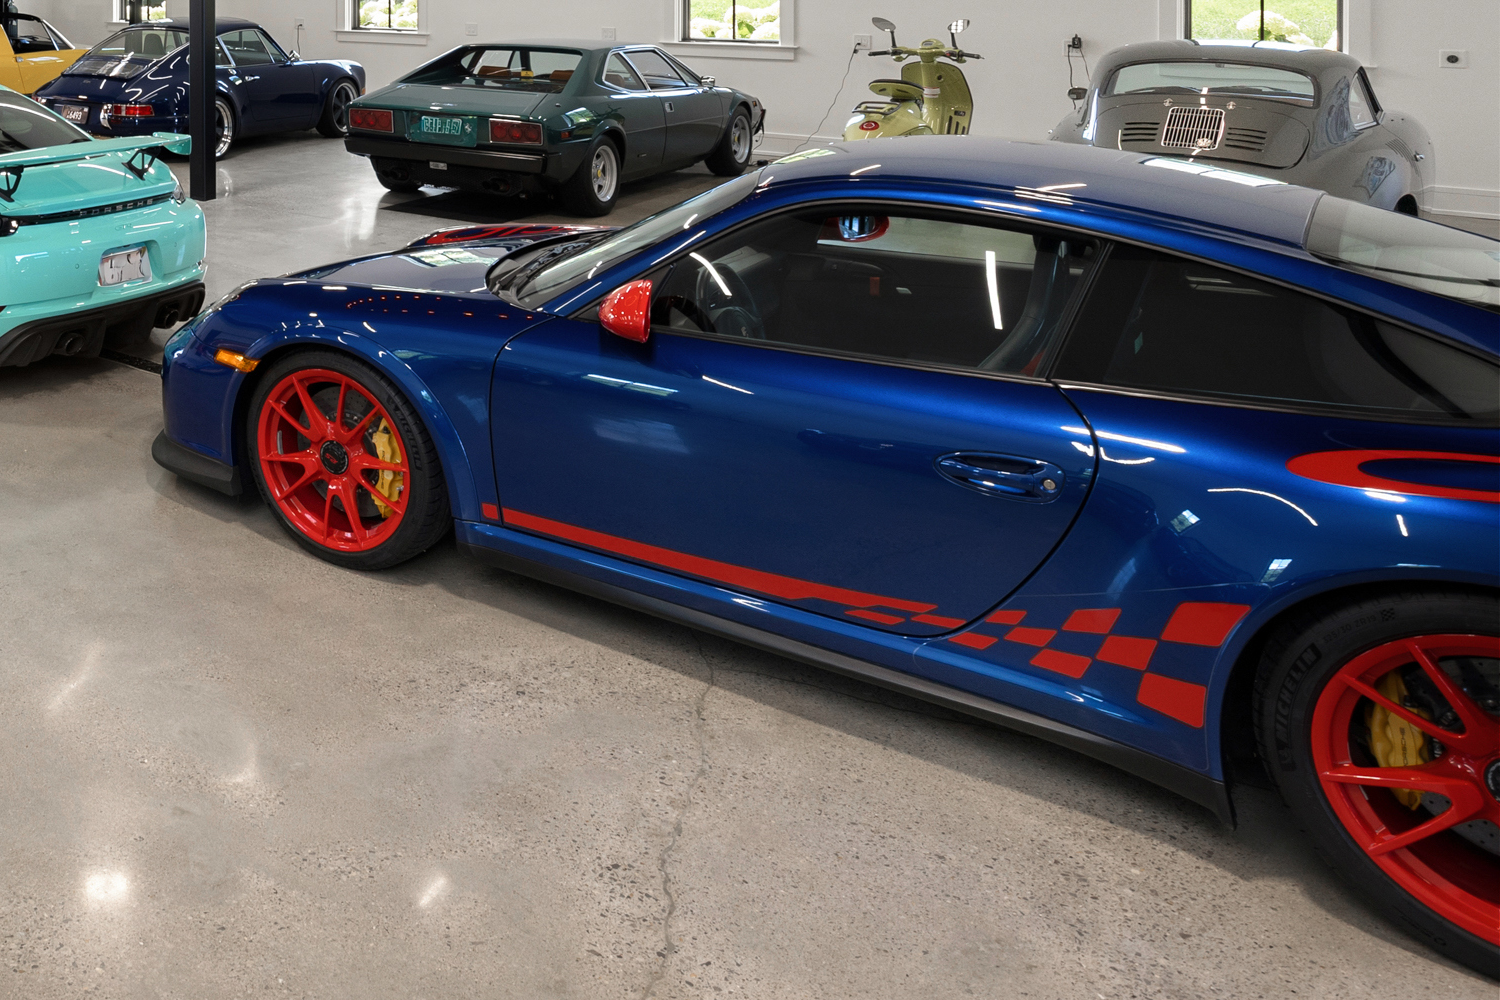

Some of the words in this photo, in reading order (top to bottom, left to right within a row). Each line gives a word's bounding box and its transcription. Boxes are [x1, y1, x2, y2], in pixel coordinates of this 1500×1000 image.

[79, 199, 154, 217] PORSCHE
[1276, 646, 1318, 741] MICHELIN
[1399, 727, 1409, 766] ORSCHE
